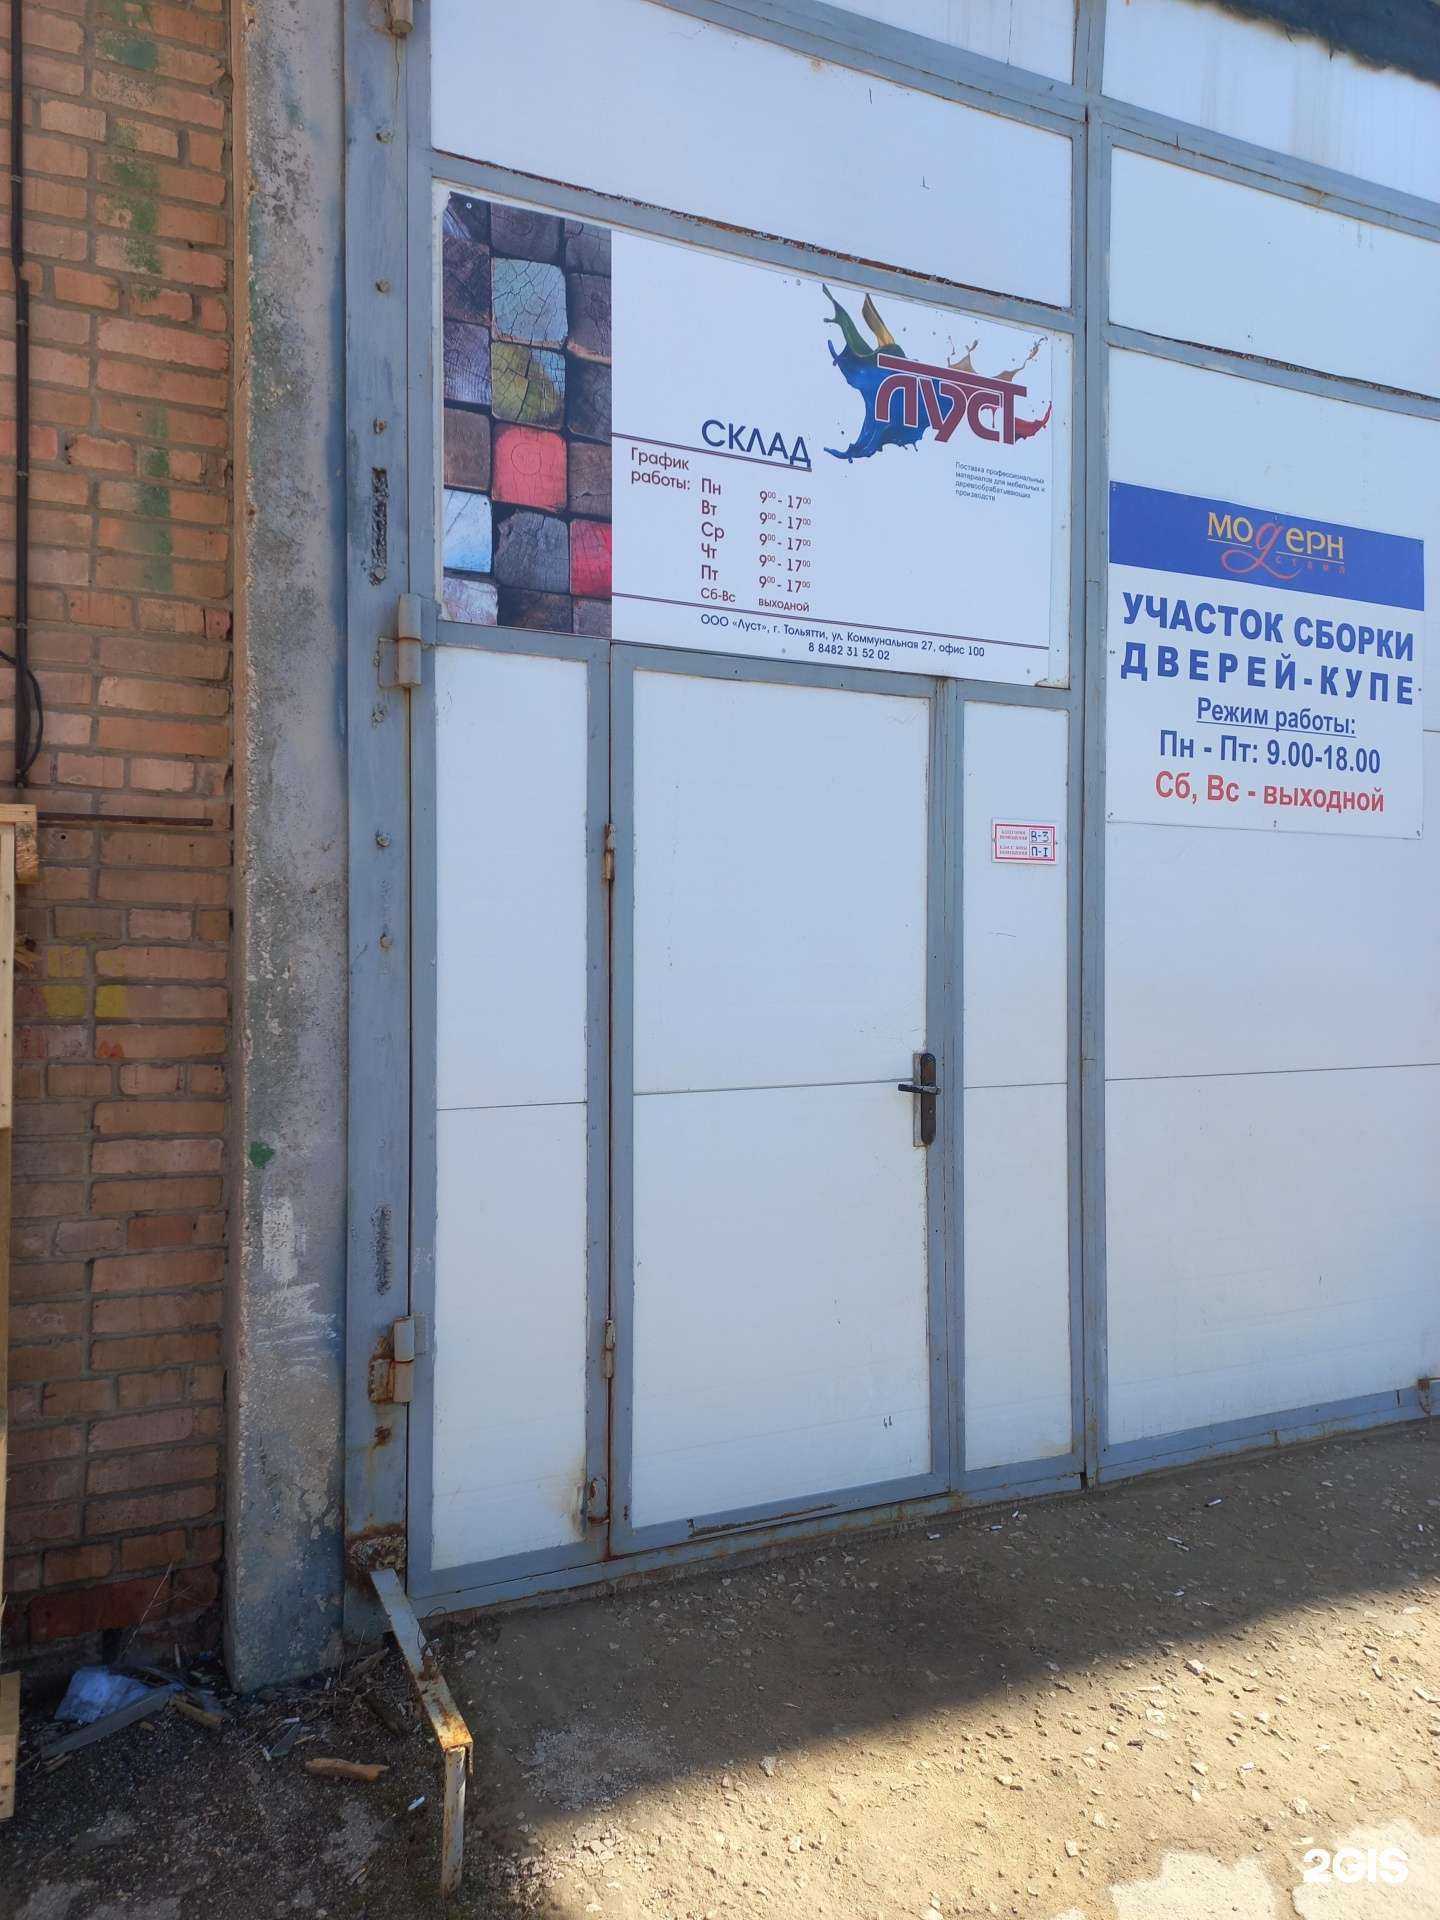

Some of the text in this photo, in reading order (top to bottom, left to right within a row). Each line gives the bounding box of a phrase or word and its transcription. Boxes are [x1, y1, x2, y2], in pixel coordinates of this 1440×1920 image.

[701, 419, 811, 468] СКЛАД
[631, 447, 689, 470] График
[955, 461, 985, 473] Поставка
[631, 470, 691, 491] работы:
[701, 478, 721, 495] Пн
[701, 500, 717, 516] Вт
[701, 521, 725, 542] Ср
[701, 543, 717, 559] Чт
[701, 564, 719, 580] Пт
[700, 587, 810, 612] Сб-Вс выходной
[701, 614, 729, 627] ООО
[784, 624, 828, 640] Тольятти,
[847, 632, 919, 649] Коммунальная
[921, 640, 936, 653] 27,
[938, 643, 965, 656] офис
[968, 645, 985, 657] 100
[1122, 591, 1414, 661] УЧАСТОК СБОРКИ
[808, 642, 890, 660] 8 8482 31 52 02
[1198, 697, 1356, 735] Режим работы:
[1160, 729, 1194, 758] Пн
[1220, 734, 1258, 764] Пт:
[1267, 739, 1381, 774] 9.00-18.00
[1155, 770, 1198, 804] Сб,
[1207, 774, 1240, 802] Вс
[1263, 785, 1385, 814] выходной
